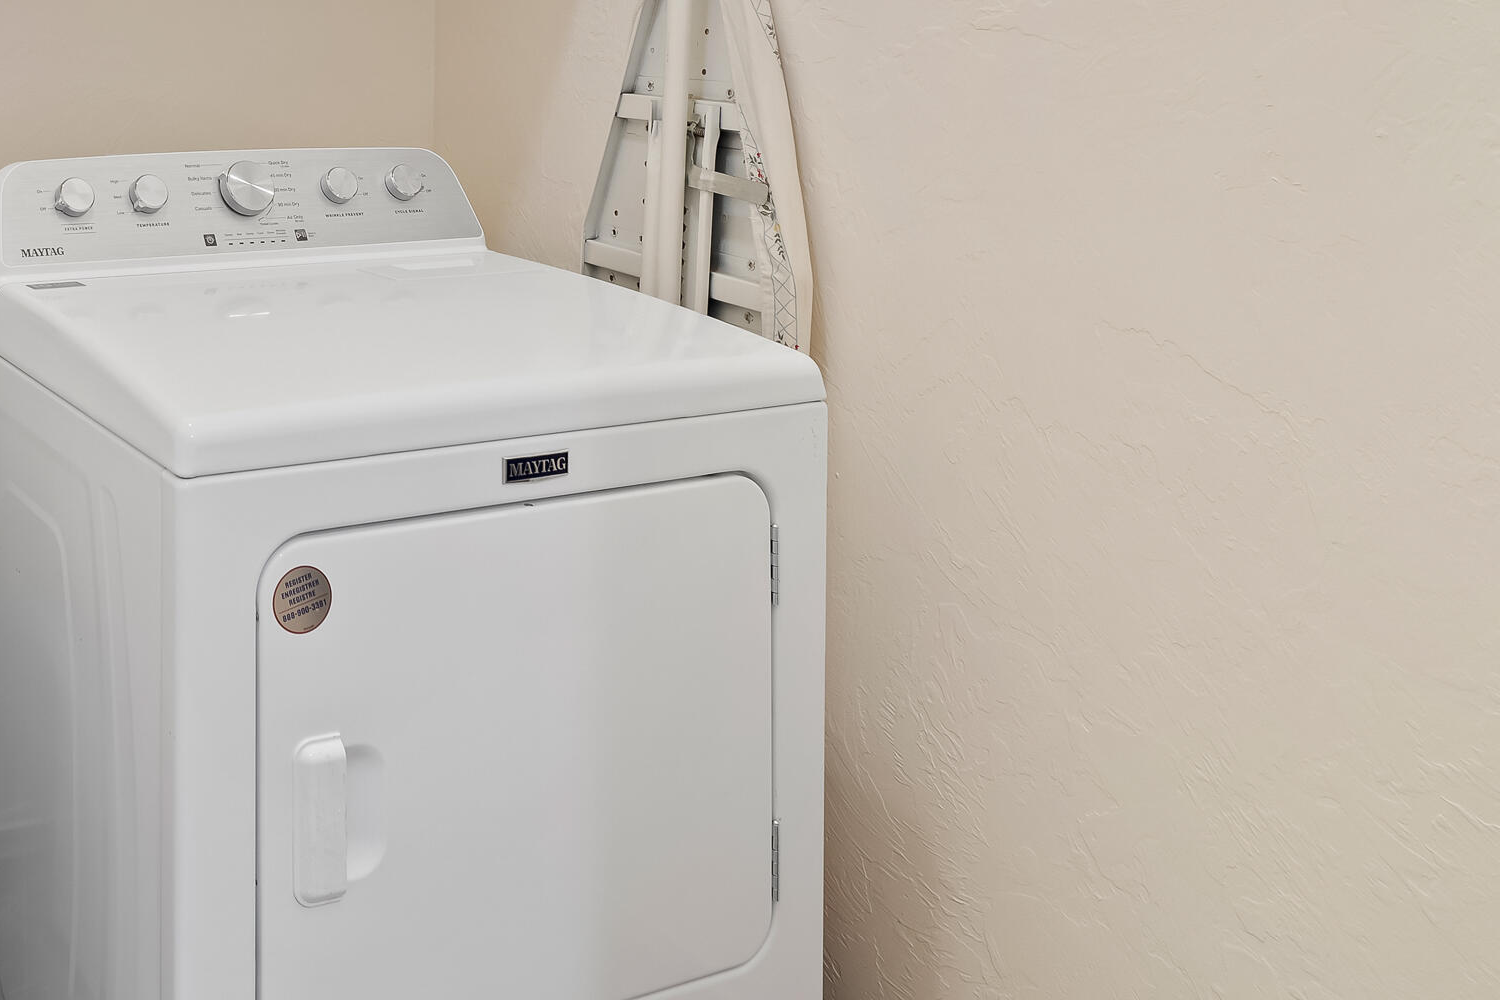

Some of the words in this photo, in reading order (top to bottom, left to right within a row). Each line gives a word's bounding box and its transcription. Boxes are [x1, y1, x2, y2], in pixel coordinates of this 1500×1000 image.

[20, 246, 65, 258] MAYTAG
[509, 456, 567, 478] MAYTAG
[285, 573, 312, 588] REGISTER
[281, 579, 320, 600] ENREGISTRER
[289, 590, 316, 606] REGISTRE
